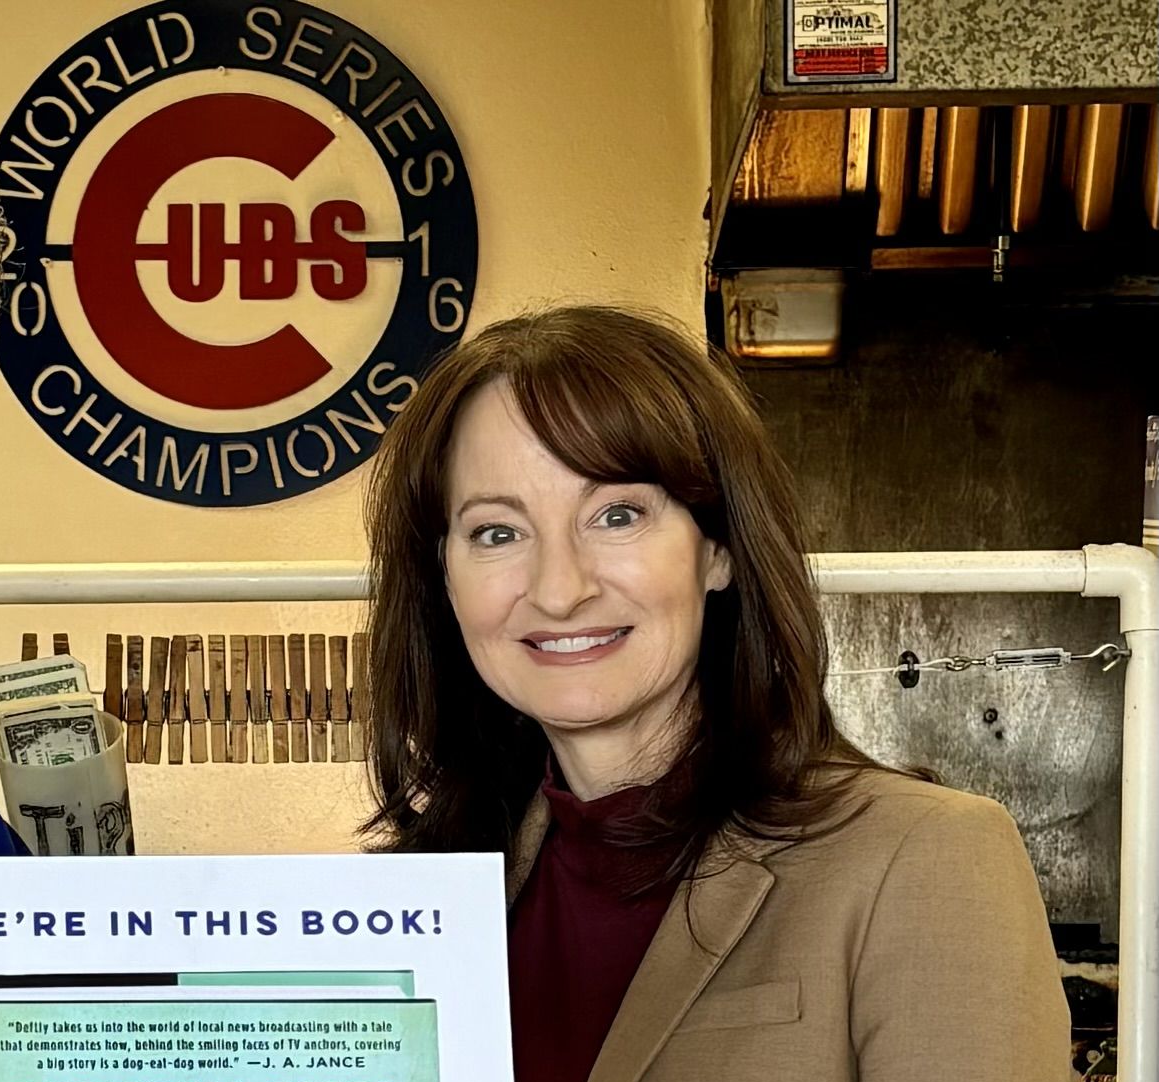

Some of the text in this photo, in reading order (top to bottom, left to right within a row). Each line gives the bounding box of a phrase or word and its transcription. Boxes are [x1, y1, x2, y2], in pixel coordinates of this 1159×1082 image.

[239, 7, 455, 197] SERIES
[73, 93, 367, 410] CUBS
[31, 362, 419, 496] CHAMPIONS
[110, 911, 153, 936] IN
[175, 910, 278, 936] THIS
[301, 909, 442, 935] BOOK!
[53, 1021, 82, 1033] takes
[86, 1023, 98, 1033] us
[101, 1021, 123, 1033] into
[127, 1021, 145, 1033] the
[149, 1021, 180, 1033] world
[183, 1021, 195, 1032] of
[198, 1021, 224, 1032] local
[228, 1023, 255, 1032] news
[259, 1020, 330, 1034] broadcasting
[334, 1020, 358, 1032] with
[361, 1023, 368, 1032] a
[371, 1020, 393, 1032] tale
[0, 1039, 401, 1052] that demonstrates how, behind the smiling faces of TV anchors, covering
[37, 1059, 44, 1070] a
[47, 1058, 65, 1071] big
[68, 1058, 97, 1071] story
[100, 1058, 110, 1069] is
[112, 1060, 119, 1069] a
[122, 1057, 194, 1071] dog-eat-dog
[282, 1057, 300, 1068] A.
[306, 1057, 366, 1068] JANCE
